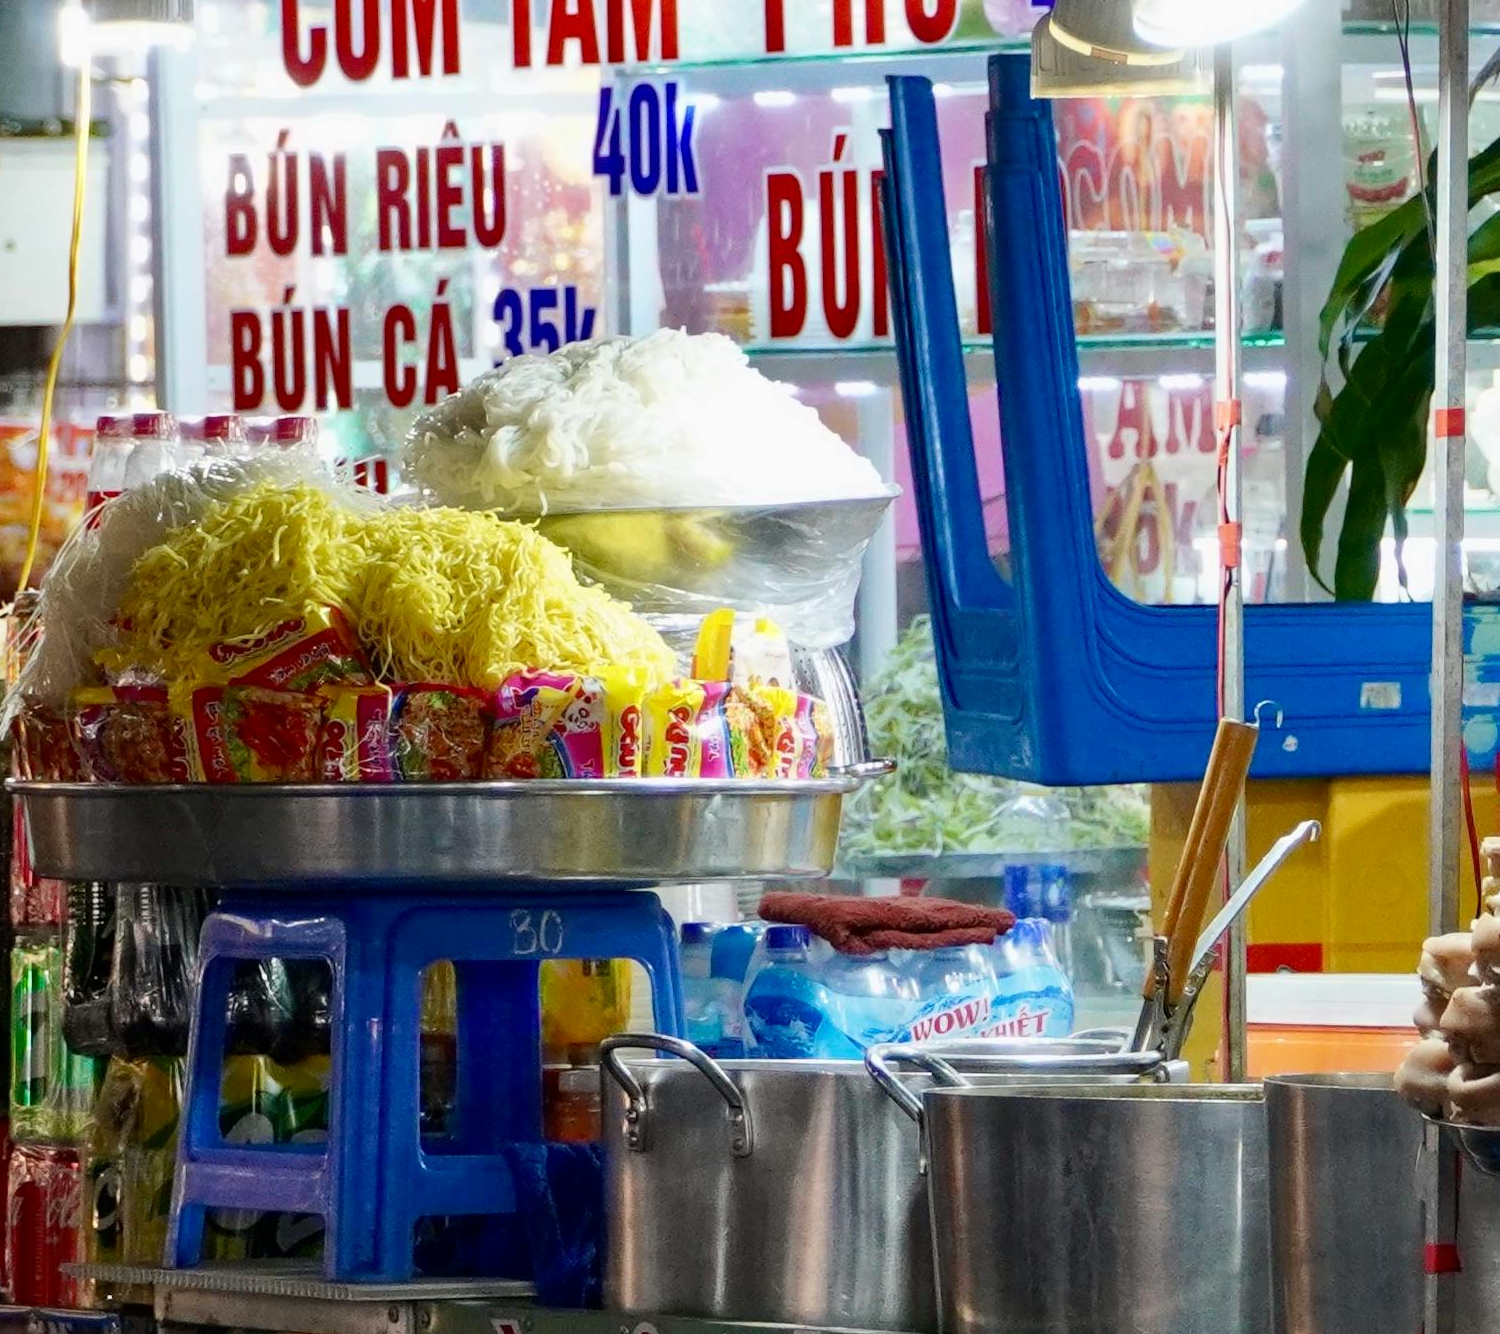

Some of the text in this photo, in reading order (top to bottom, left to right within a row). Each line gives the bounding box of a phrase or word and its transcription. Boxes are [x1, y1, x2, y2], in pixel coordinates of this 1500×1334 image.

[225, 120, 507, 259] BÚN RIÊU
[593, 80, 699, 197] 40k
[230, 278, 461, 412] BÚN CÁ
[911, 996, 991, 1043] WOW!
